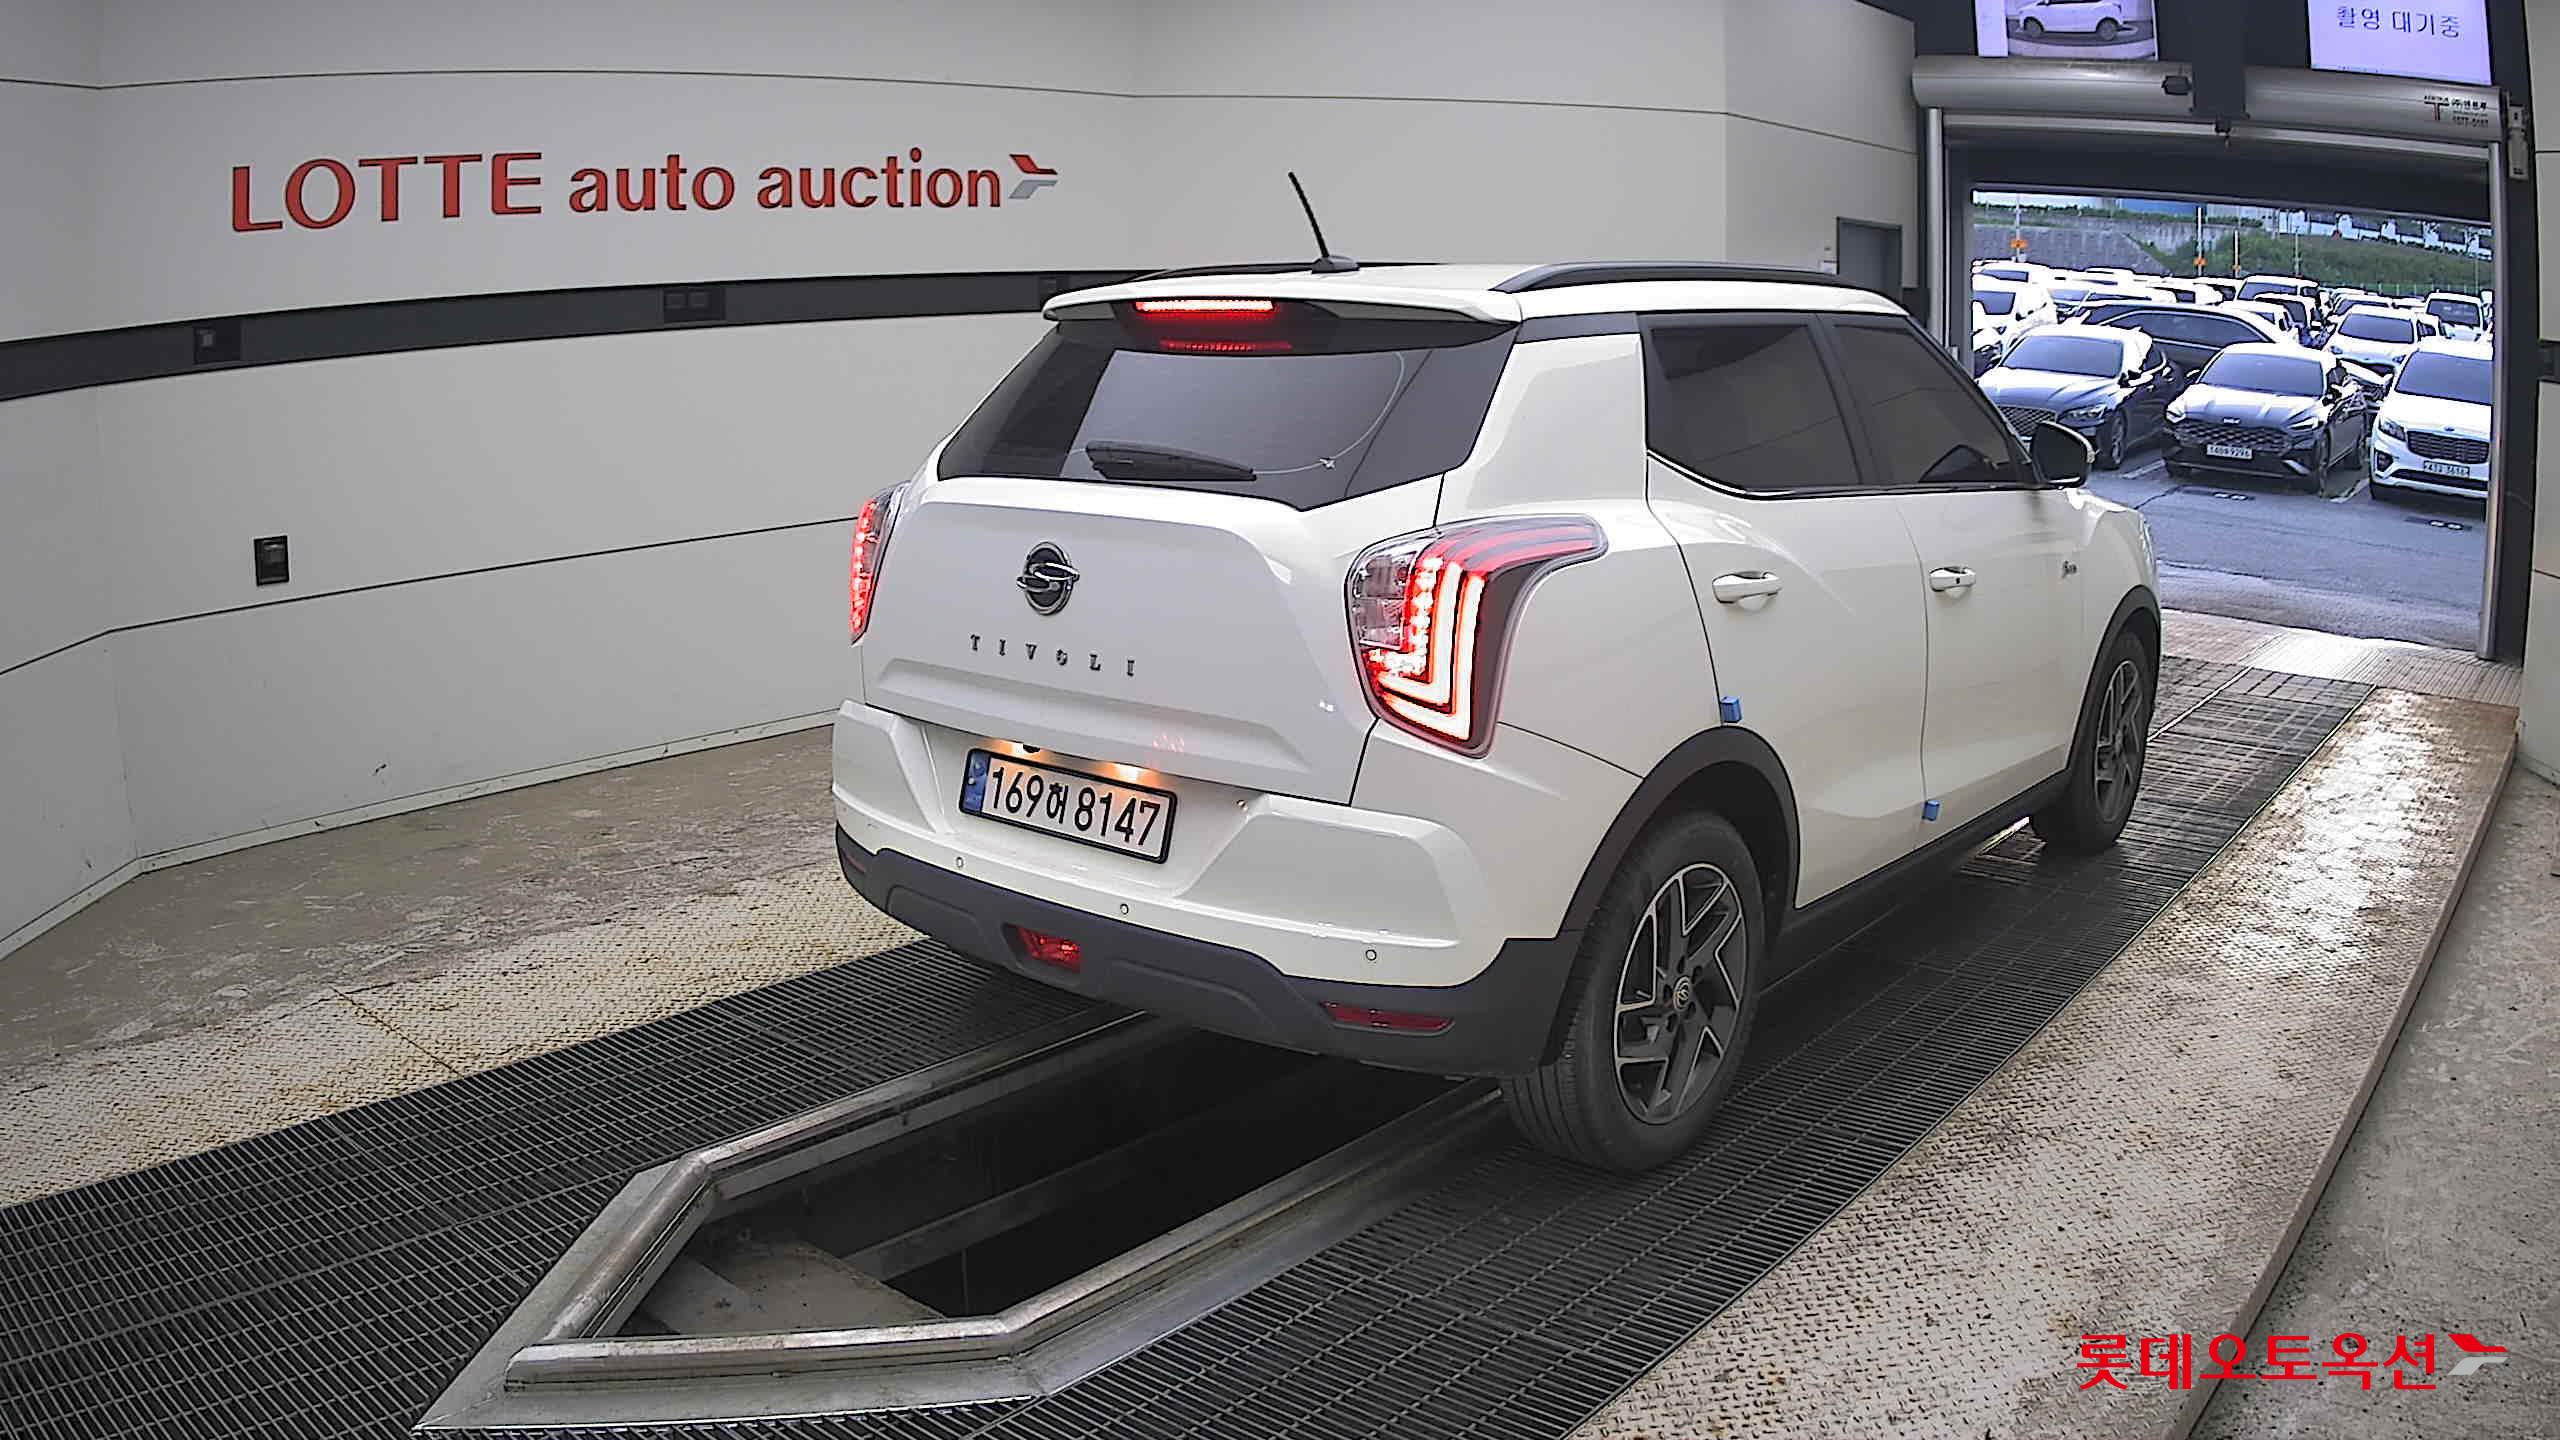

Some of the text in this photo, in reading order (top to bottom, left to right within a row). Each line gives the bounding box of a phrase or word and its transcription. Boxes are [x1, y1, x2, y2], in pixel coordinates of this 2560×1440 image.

[2392, 11, 2460, 38] 대기중
[231, 147, 1002, 232] LOTTE auto auction
[970, 633, 1136, 676] TIVOLI
[1074, 786, 1161, 846] 8147
